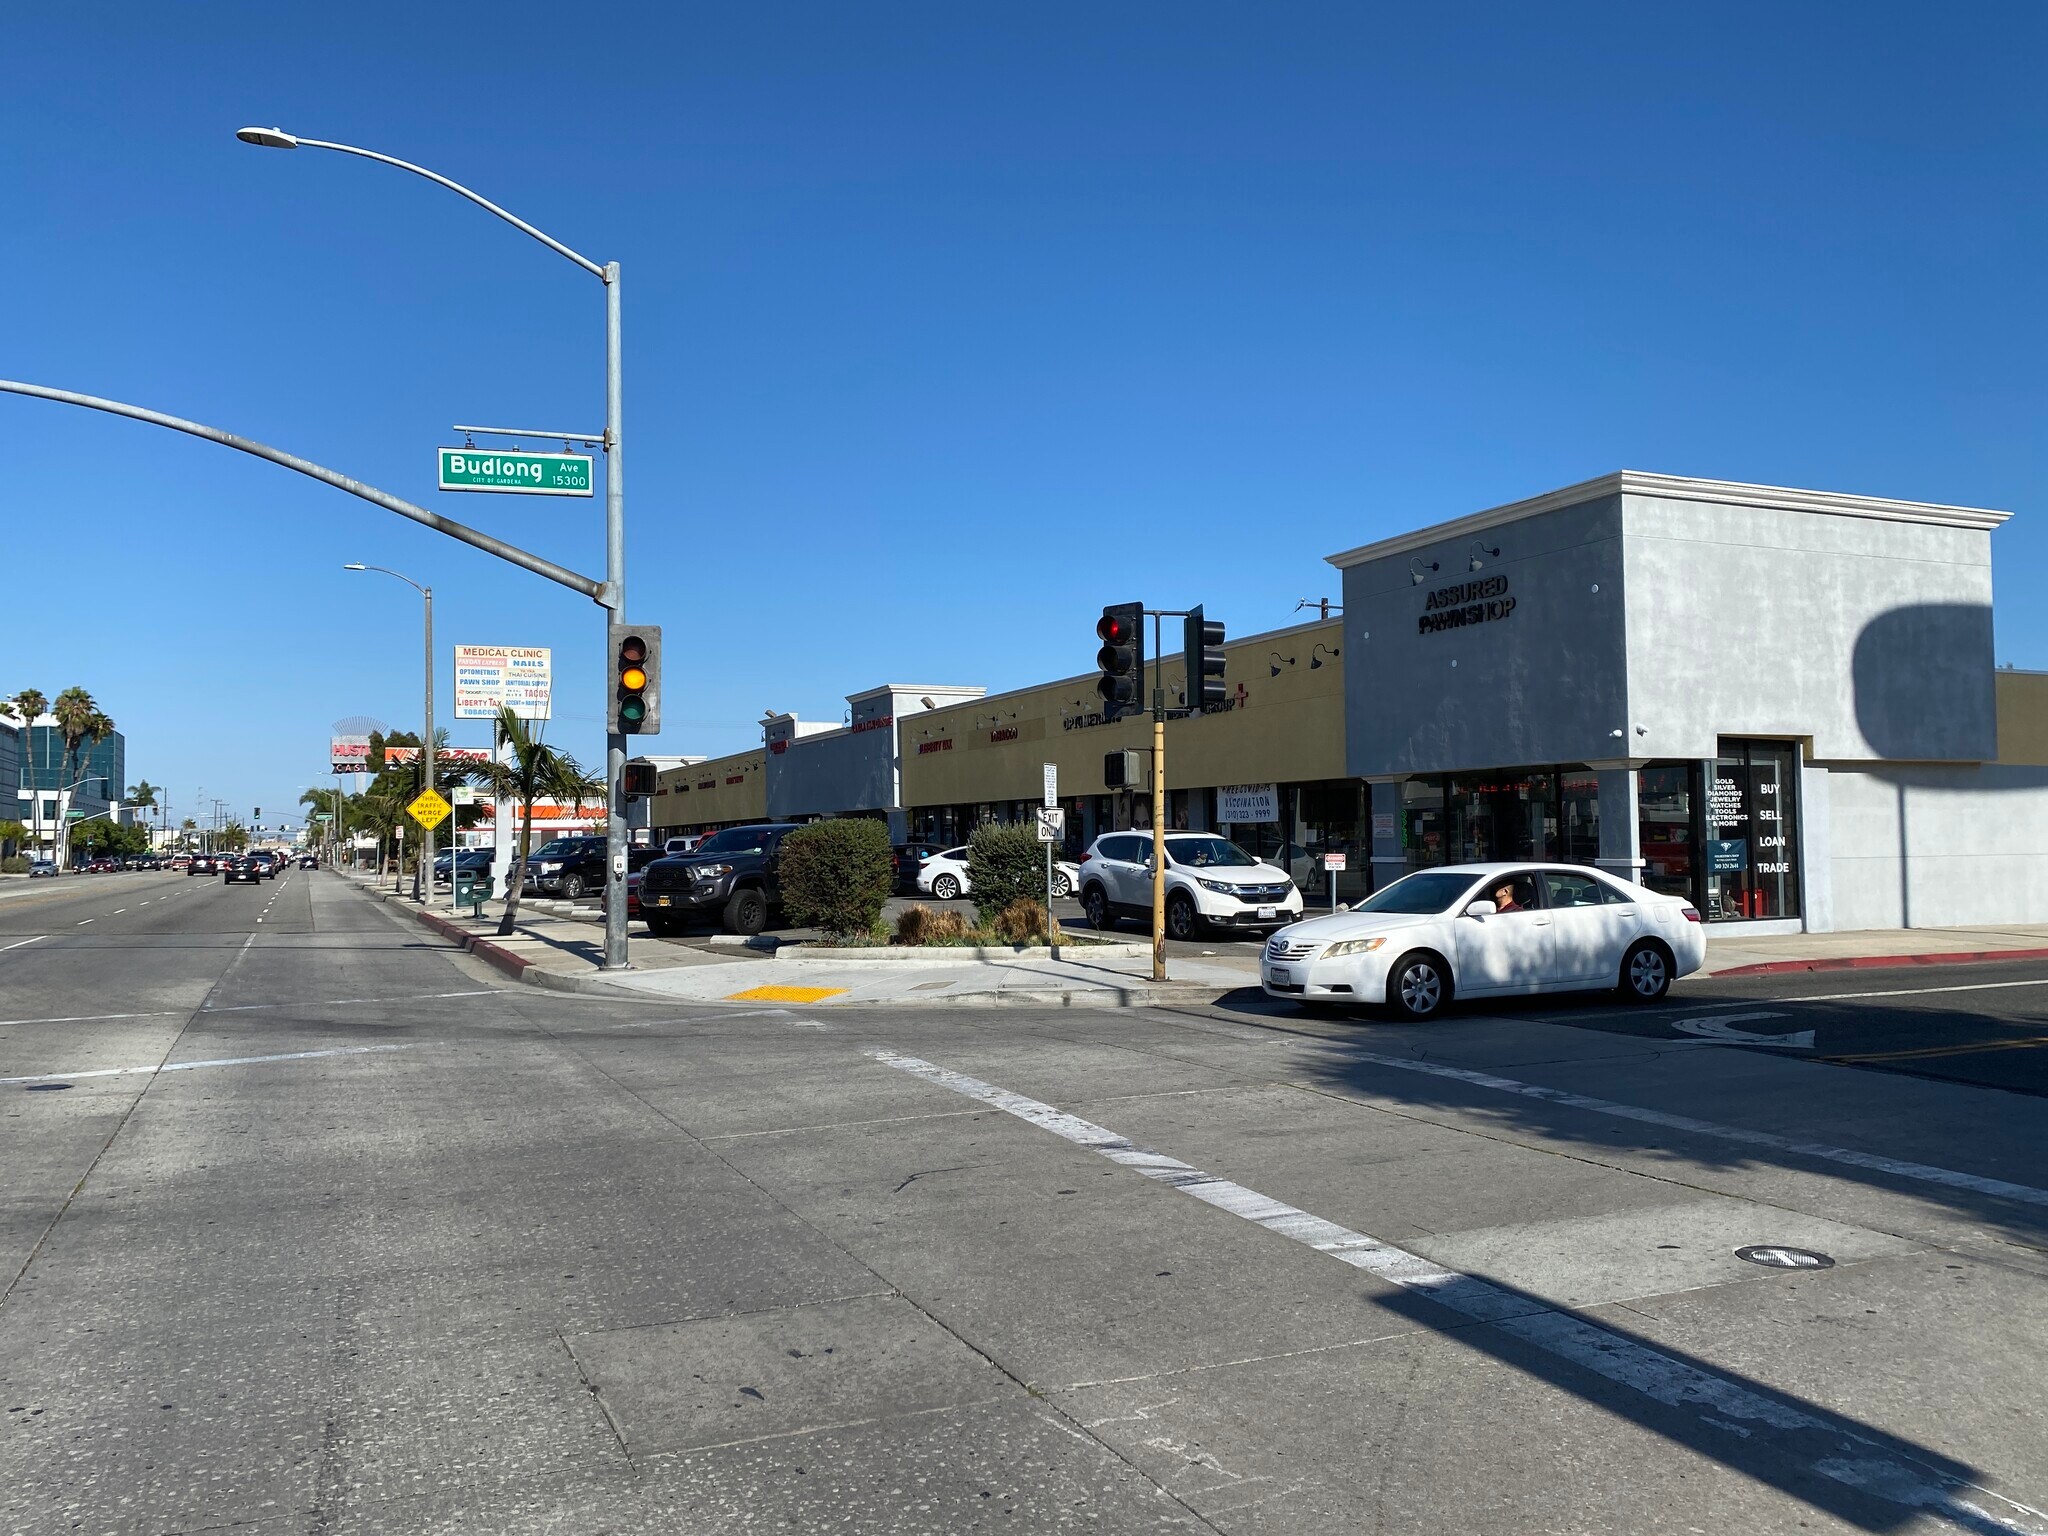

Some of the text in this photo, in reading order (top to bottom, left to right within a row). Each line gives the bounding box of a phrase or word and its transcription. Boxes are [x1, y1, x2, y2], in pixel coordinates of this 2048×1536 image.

[450, 455, 579, 483] Budlong Ave
[552, 475, 586, 487] 15300
[1425, 574, 1508, 611] ASSURED
[464, 648, 542, 658] MEDICAL CLINIC
[524, 689, 548, 698] TACOS
[457, 697, 502, 707] LIBERTY TAX
[333, 744, 371, 757] HUST
[336, 764, 368, 772] CASI
[1760, 784, 1780, 794] BUY
[572, 805, 608, 820] Auto
[1043, 813, 1059, 823] EXIT
[1759, 810, 1783, 820] SELL
[1041, 826, 1061, 837] ONLY
[1759, 836, 1786, 847] LOAN
[1757, 862, 1790, 873] TRADE
